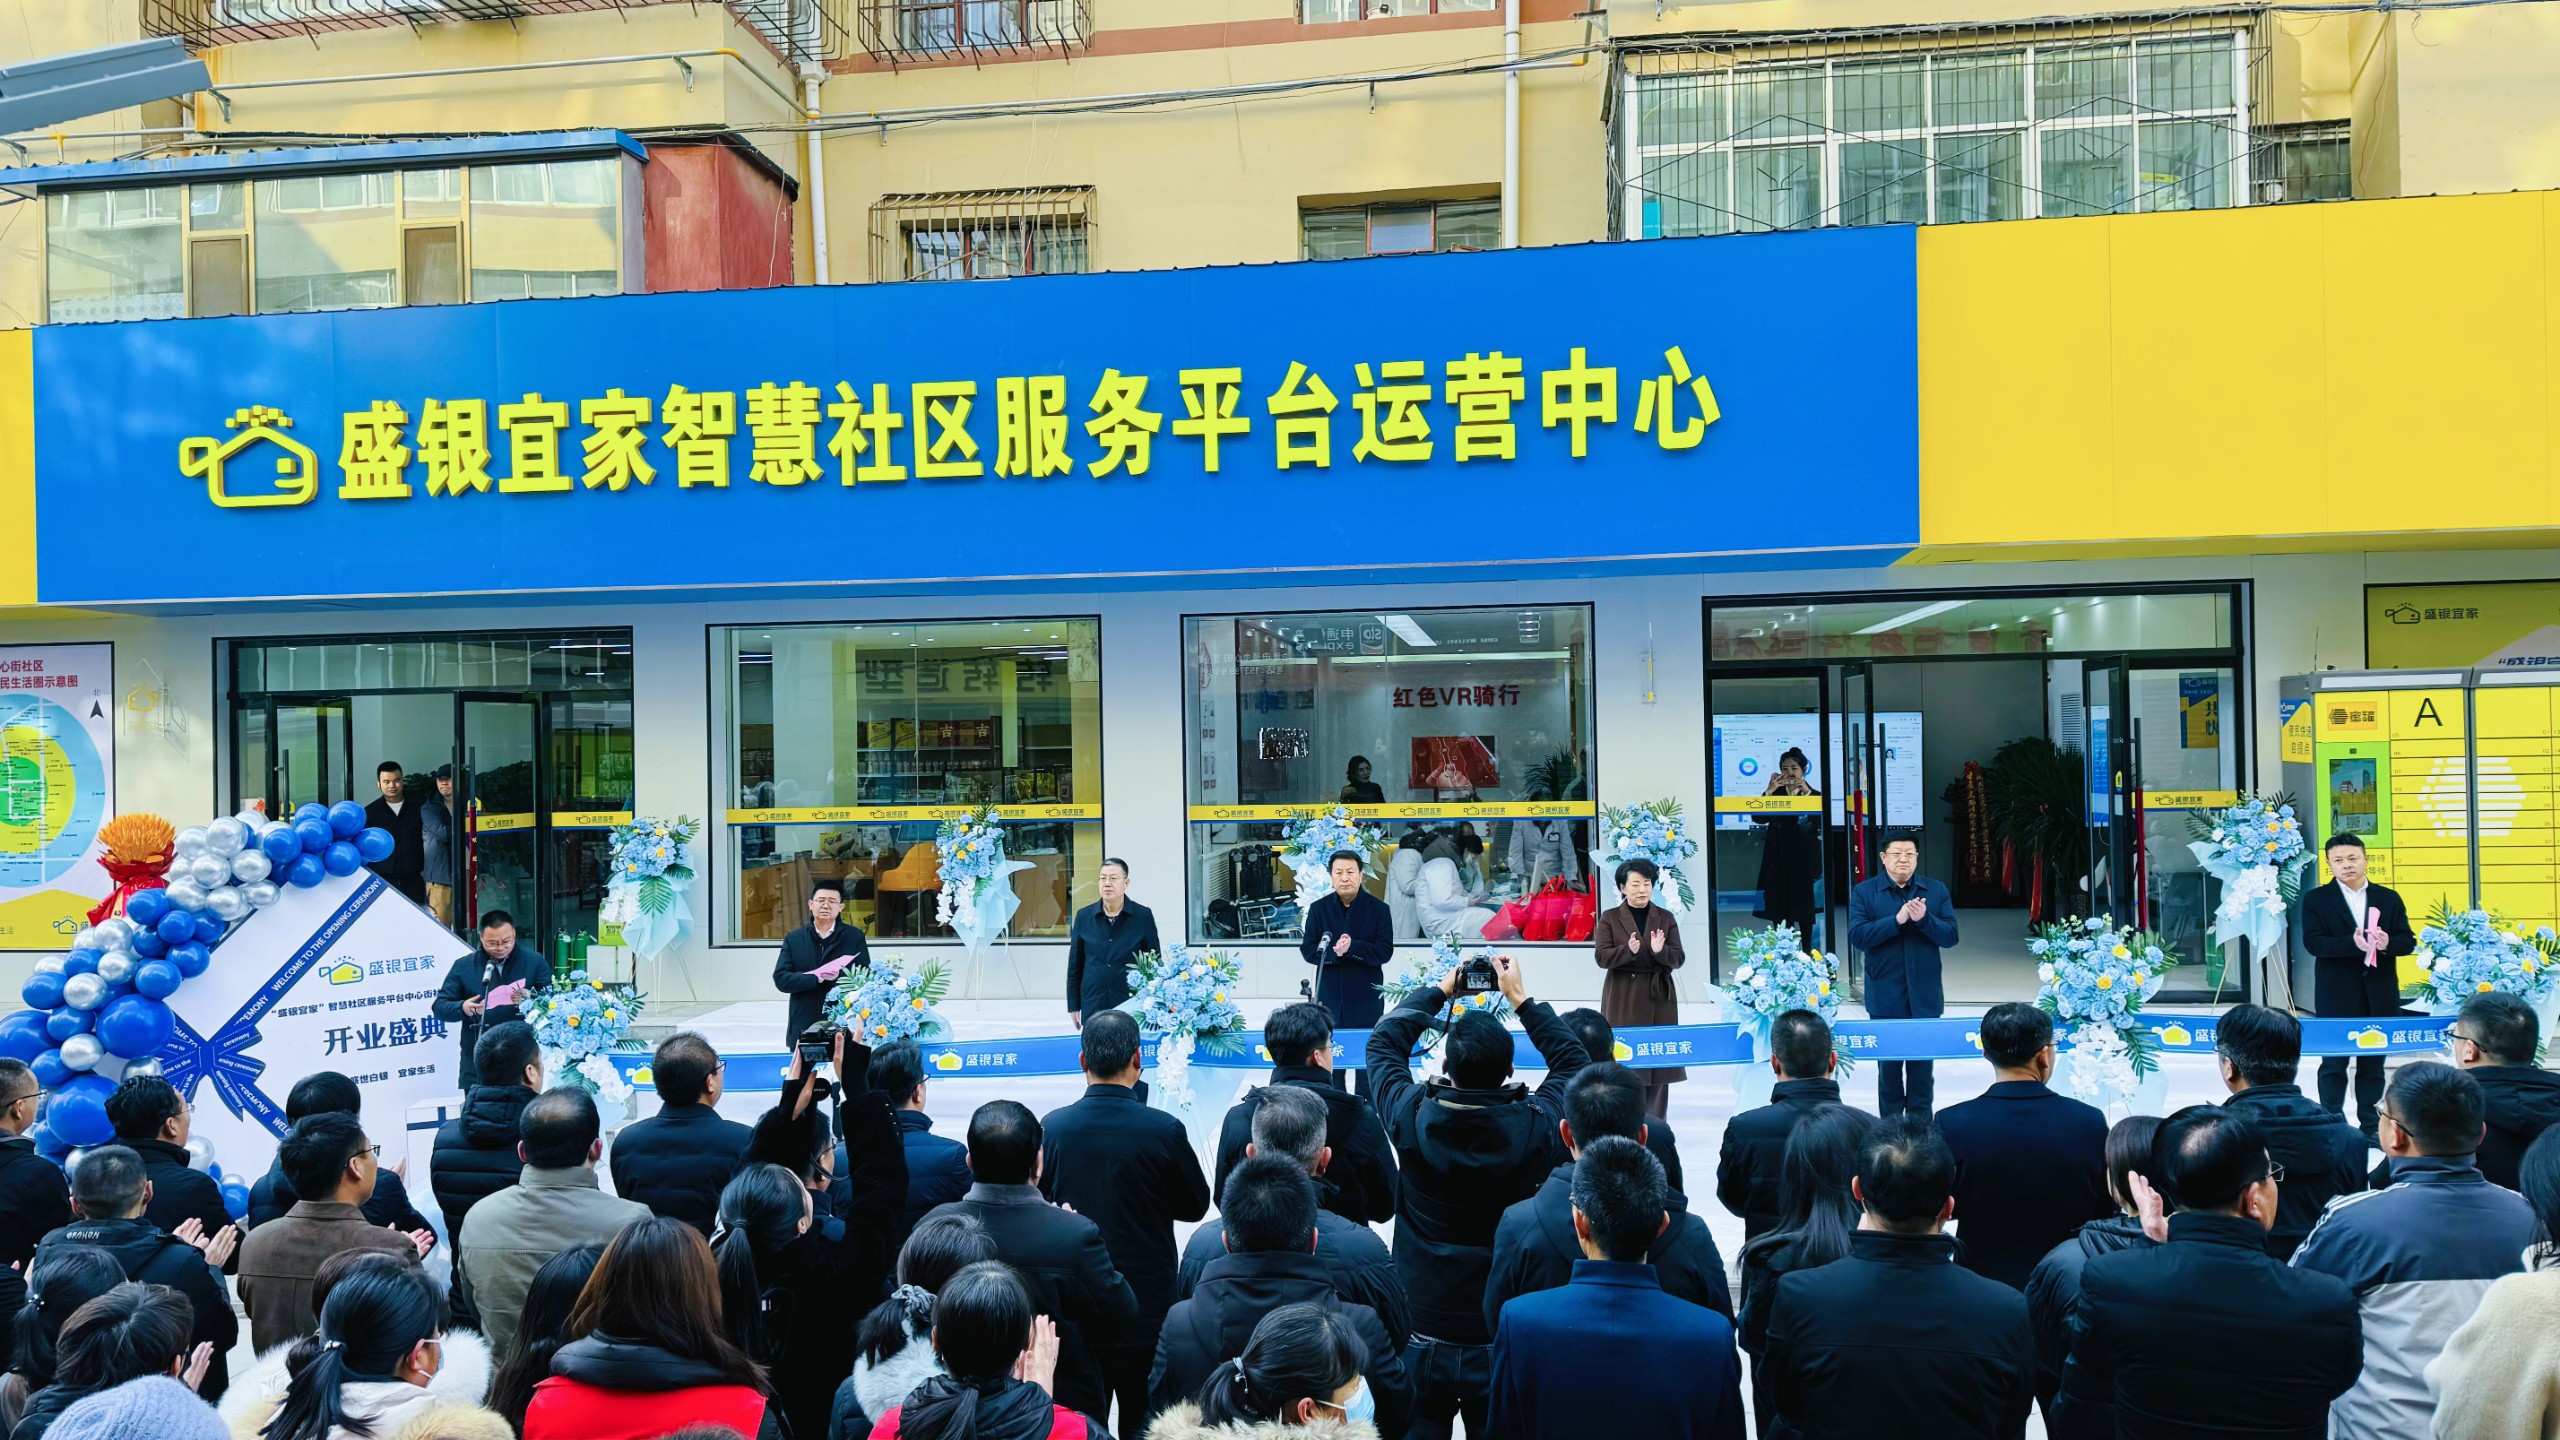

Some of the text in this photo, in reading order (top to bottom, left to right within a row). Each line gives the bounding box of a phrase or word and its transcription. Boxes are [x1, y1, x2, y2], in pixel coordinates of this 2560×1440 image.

[338, 345, 1721, 499] 盛银宜家智慧社区服务平台运营中心
[2425, 608, 2479, 620] 盛银宜家
[1393, 684, 1521, 708] 红色VR骑行
[2414, 698, 2443, 727] A
[271, 878, 382, 991] WELCOME TO THE OPENING CEREMONY
[368, 955, 436, 977] 盛银宜家
[324, 1014, 449, 1056] 开业盛典
[1636, 1041, 1693, 1055] 盛银宜家
[398, 1064, 436, 1078] 宜家生活
[966, 1053, 1018, 1067] 盛银宜家
